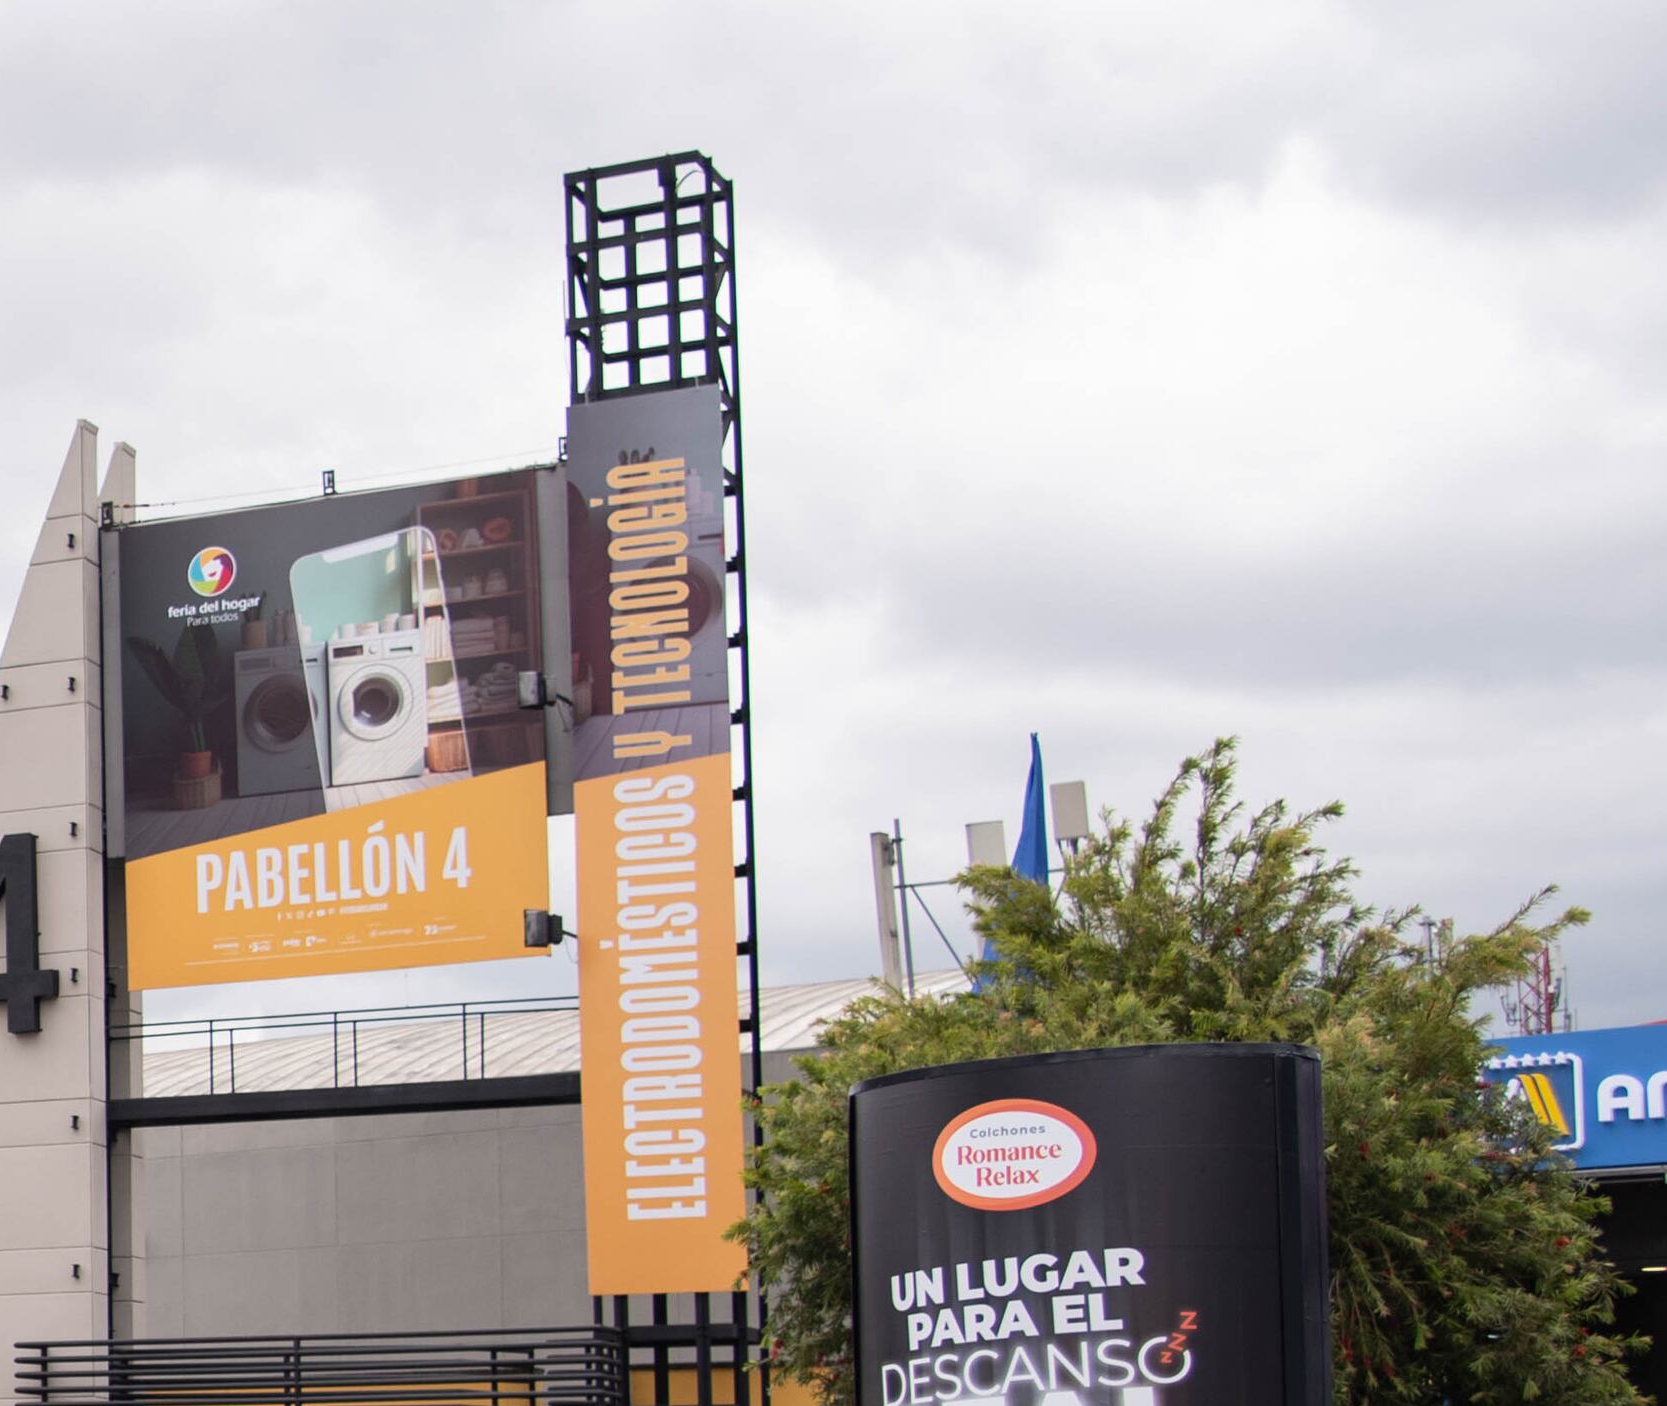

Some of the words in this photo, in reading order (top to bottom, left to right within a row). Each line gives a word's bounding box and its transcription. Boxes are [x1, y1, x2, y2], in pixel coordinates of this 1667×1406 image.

[168, 604, 196, 618] feria
[199, 600, 219, 614] del
[221, 596, 261, 612] hogar
[590, 456, 692, 715] TECNOLOGÍA
[196, 821, 427, 914] PABELLÓN
[442, 826, 473, 889] 4
[599, 774, 707, 1220] ELECTRODOMÉSTICOS
[957, 1142, 1062, 1166] Romance
[970, 1124, 1046, 1139] Colchones
[976, 1164, 1040, 1188] Relax
[891, 1267, 945, 1312] UN
[956, 1248, 1146, 1302] LUGAR
[907, 1300, 1038, 1351] PARA
[1052, 1292, 1123, 1335] EL
